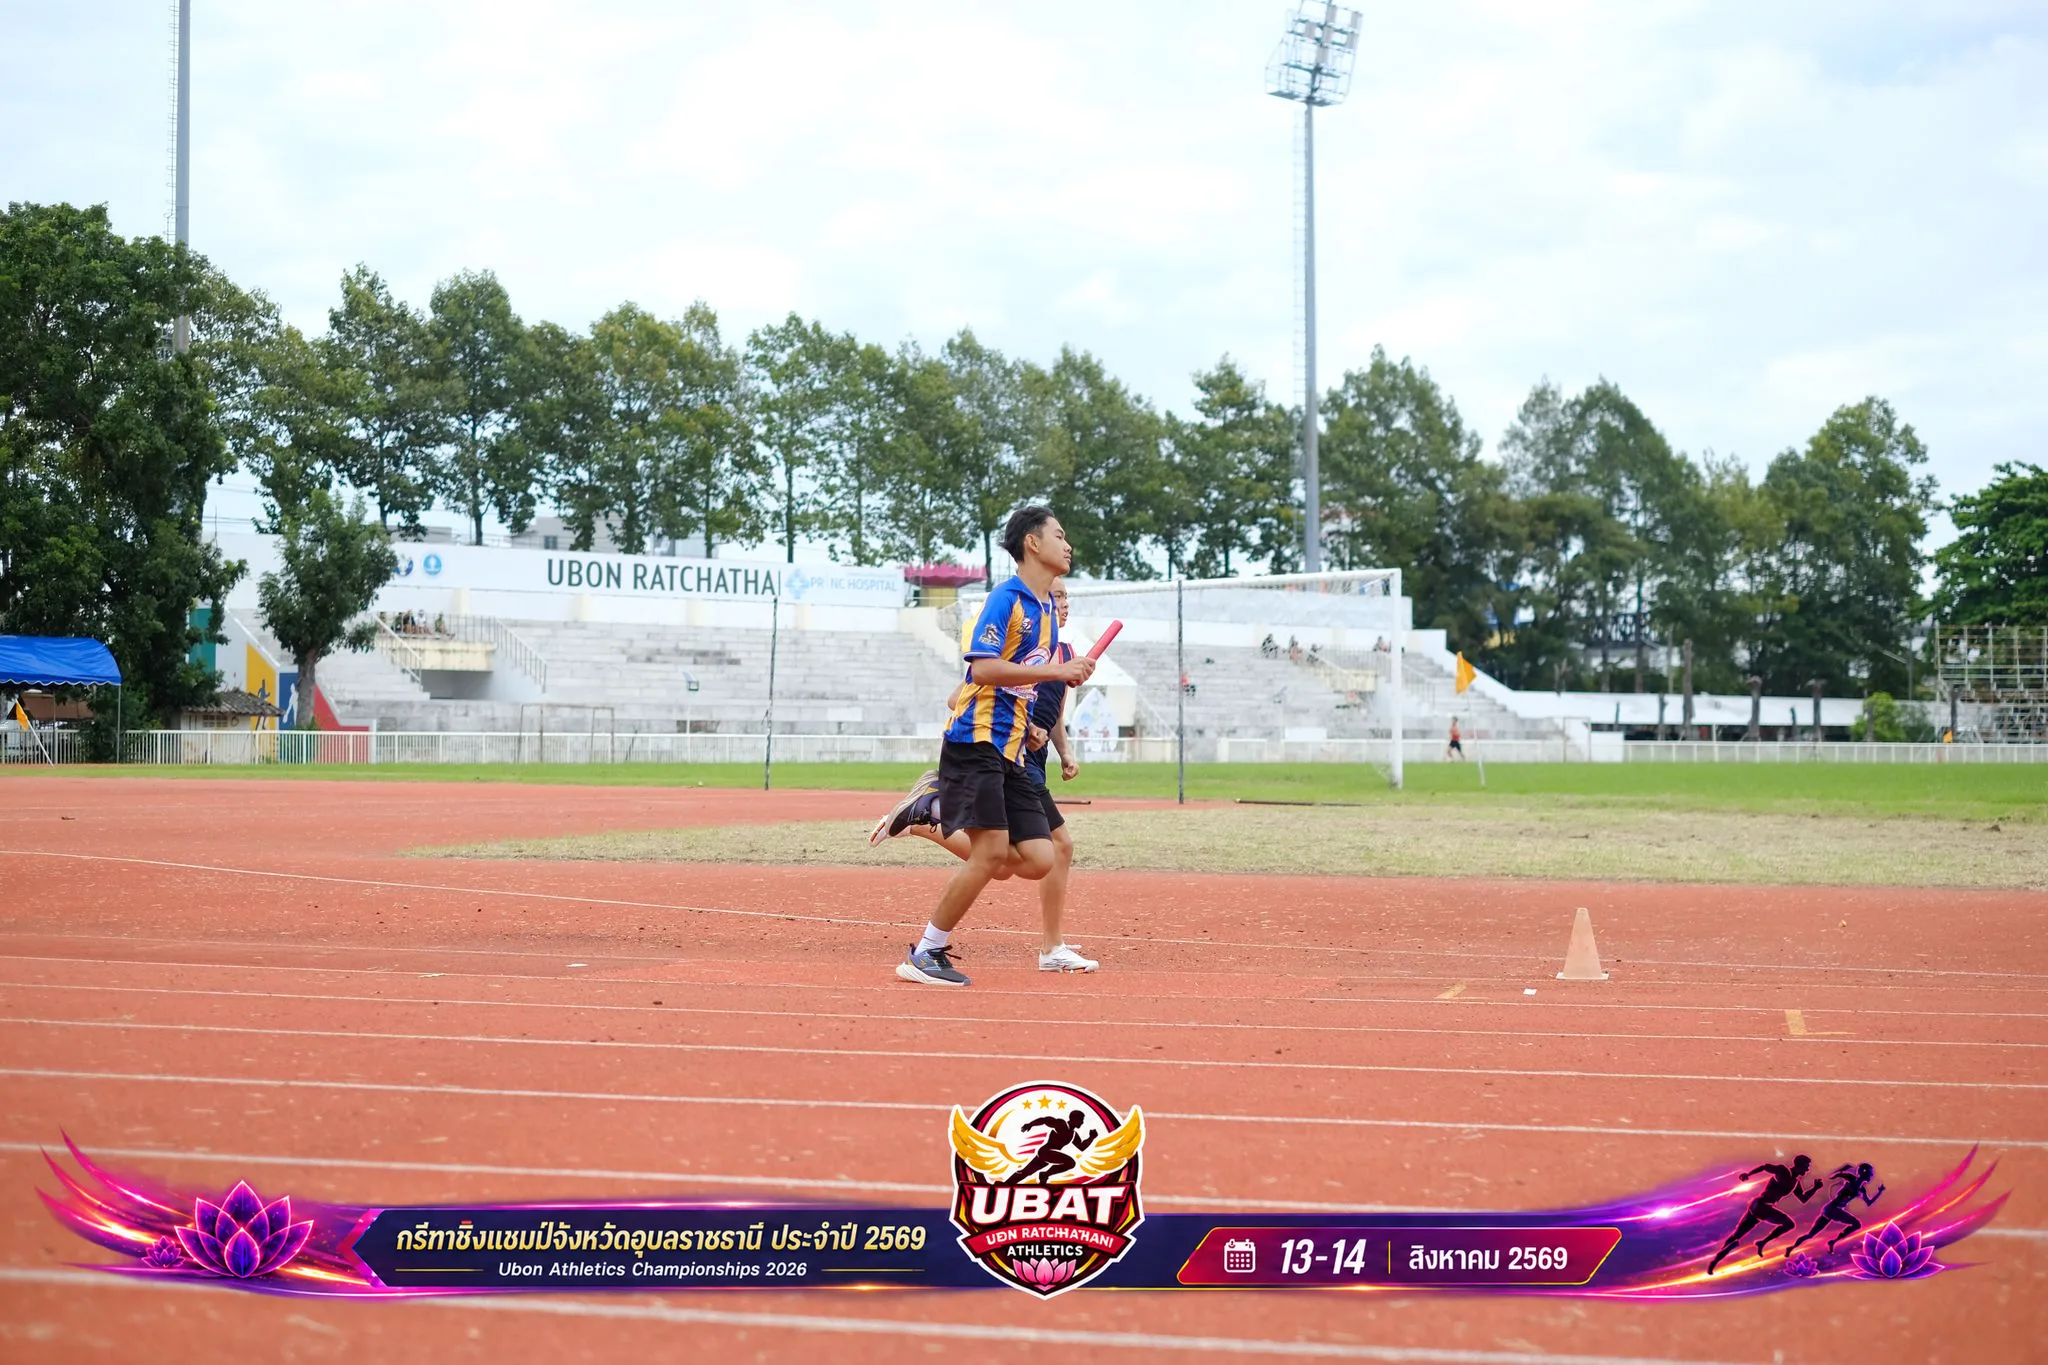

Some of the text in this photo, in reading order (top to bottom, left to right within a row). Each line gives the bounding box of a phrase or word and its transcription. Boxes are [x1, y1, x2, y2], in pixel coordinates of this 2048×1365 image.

[548, 559, 781, 596] UBON RATCHATHA
[847, 579, 898, 593] HOSPITAL
